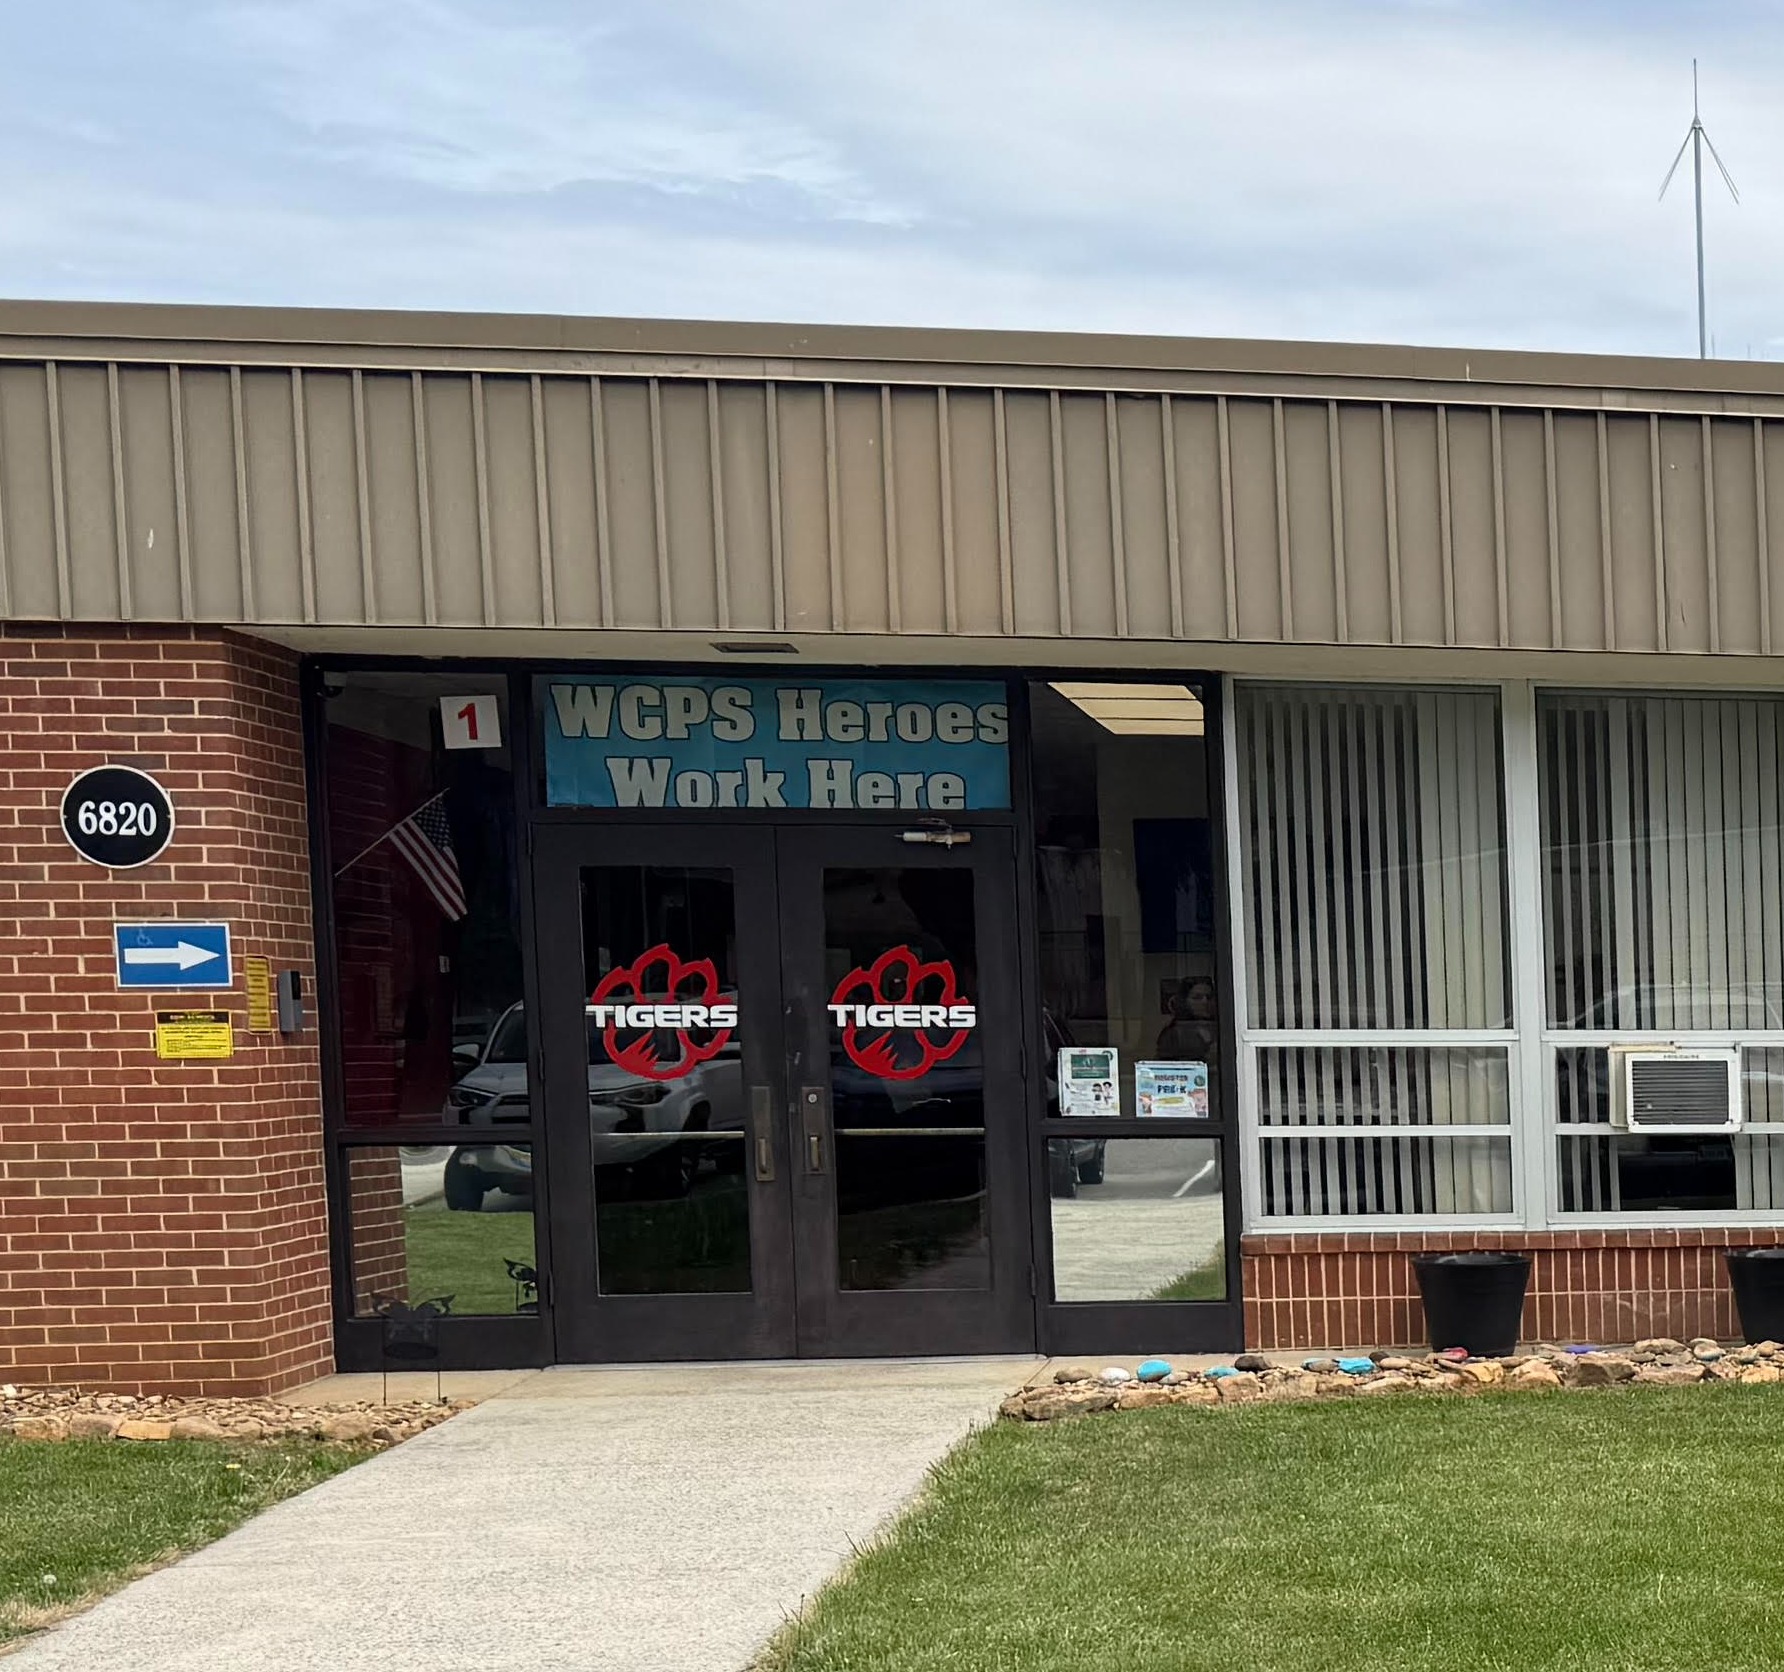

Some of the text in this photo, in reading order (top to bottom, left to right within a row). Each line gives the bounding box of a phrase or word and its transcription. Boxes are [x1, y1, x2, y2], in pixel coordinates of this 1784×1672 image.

[458, 703, 478, 740] 1
[550, 684, 1008, 744] WCPS Heroes
[604, 756, 966, 809] Work Here
[78, 800, 157, 837] 6820
[585, 1004, 738, 1029] TIGERS
[827, 1004, 976, 1029] TIGERS
